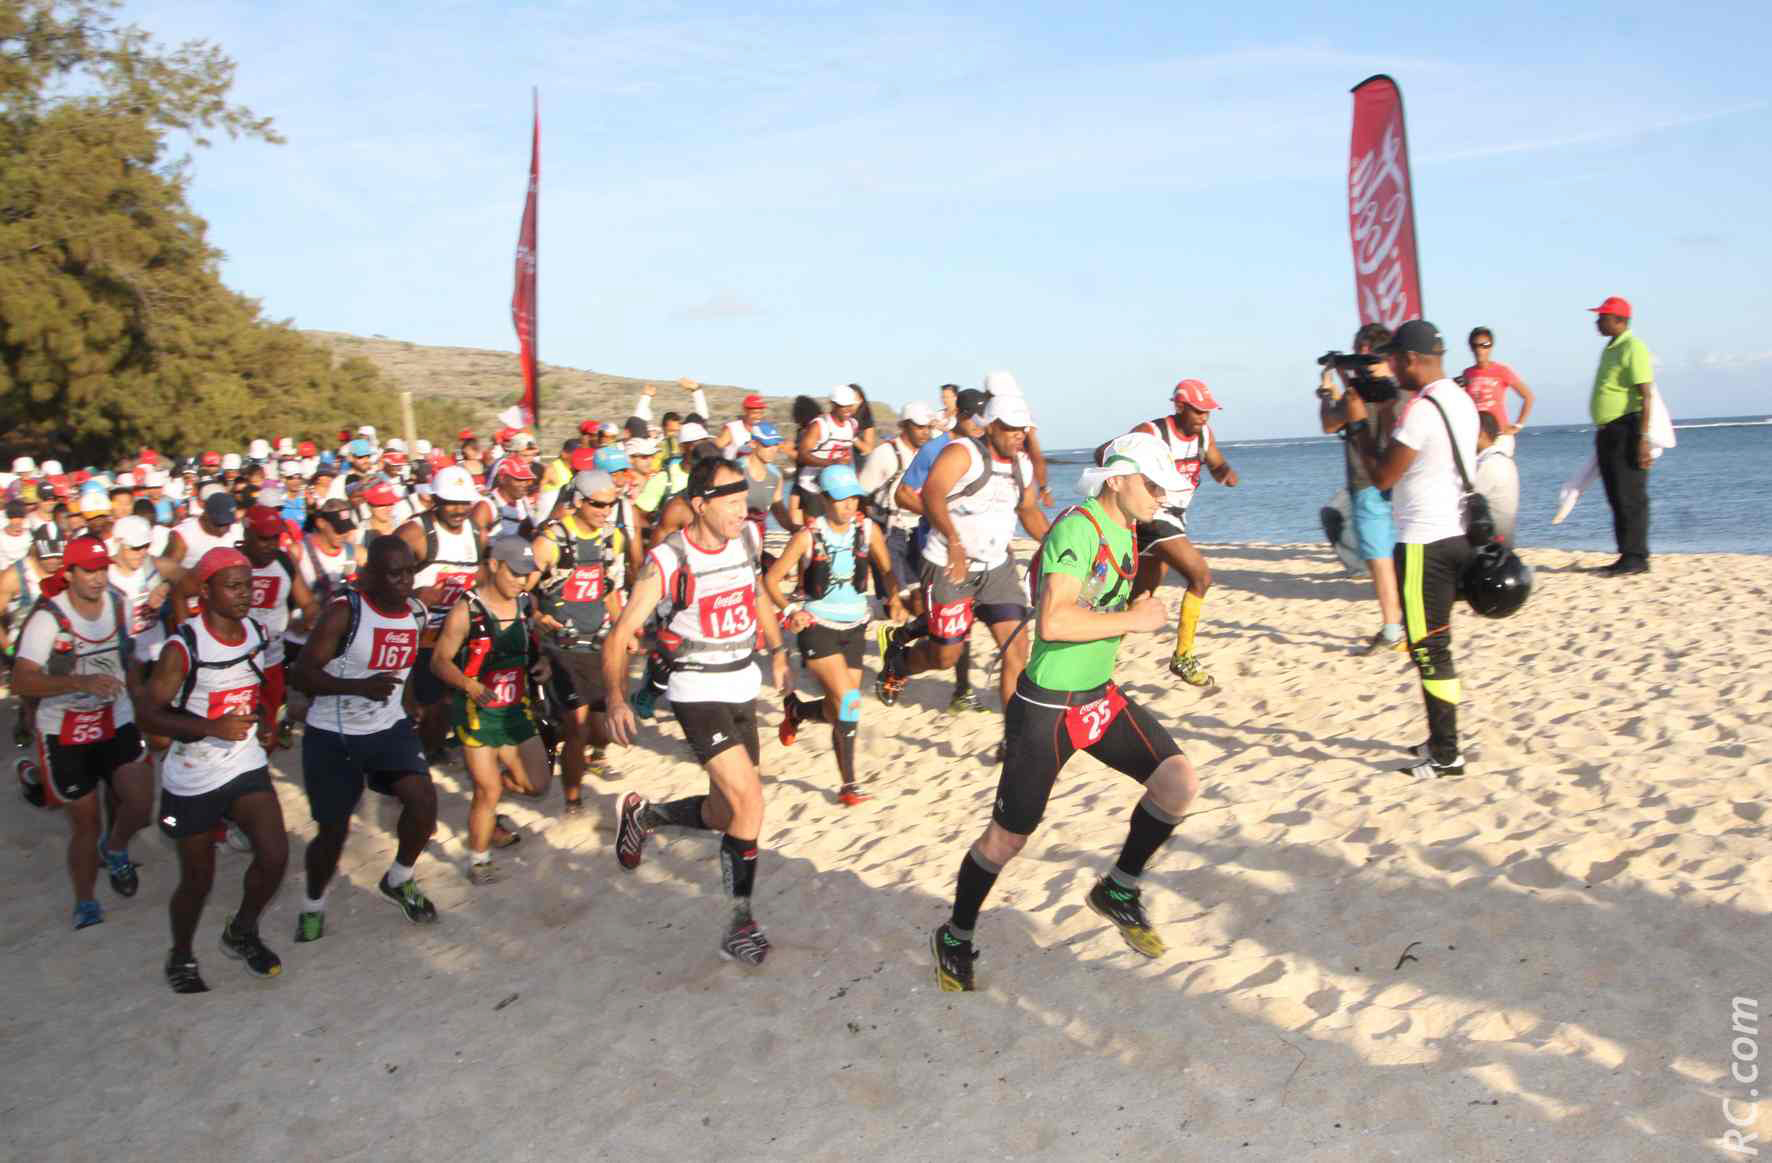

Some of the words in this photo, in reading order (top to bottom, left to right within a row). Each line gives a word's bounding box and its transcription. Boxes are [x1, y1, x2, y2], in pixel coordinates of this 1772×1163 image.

[575, 580, 599, 600] 74
[709, 604, 751, 638] 143
[937, 613, 967, 636] 144
[384, 631, 410, 644] Coca-Cola
[375, 644, 413, 668] 167
[1081, 699, 1112, 741] 25
[71, 722, 104, 743] 55
